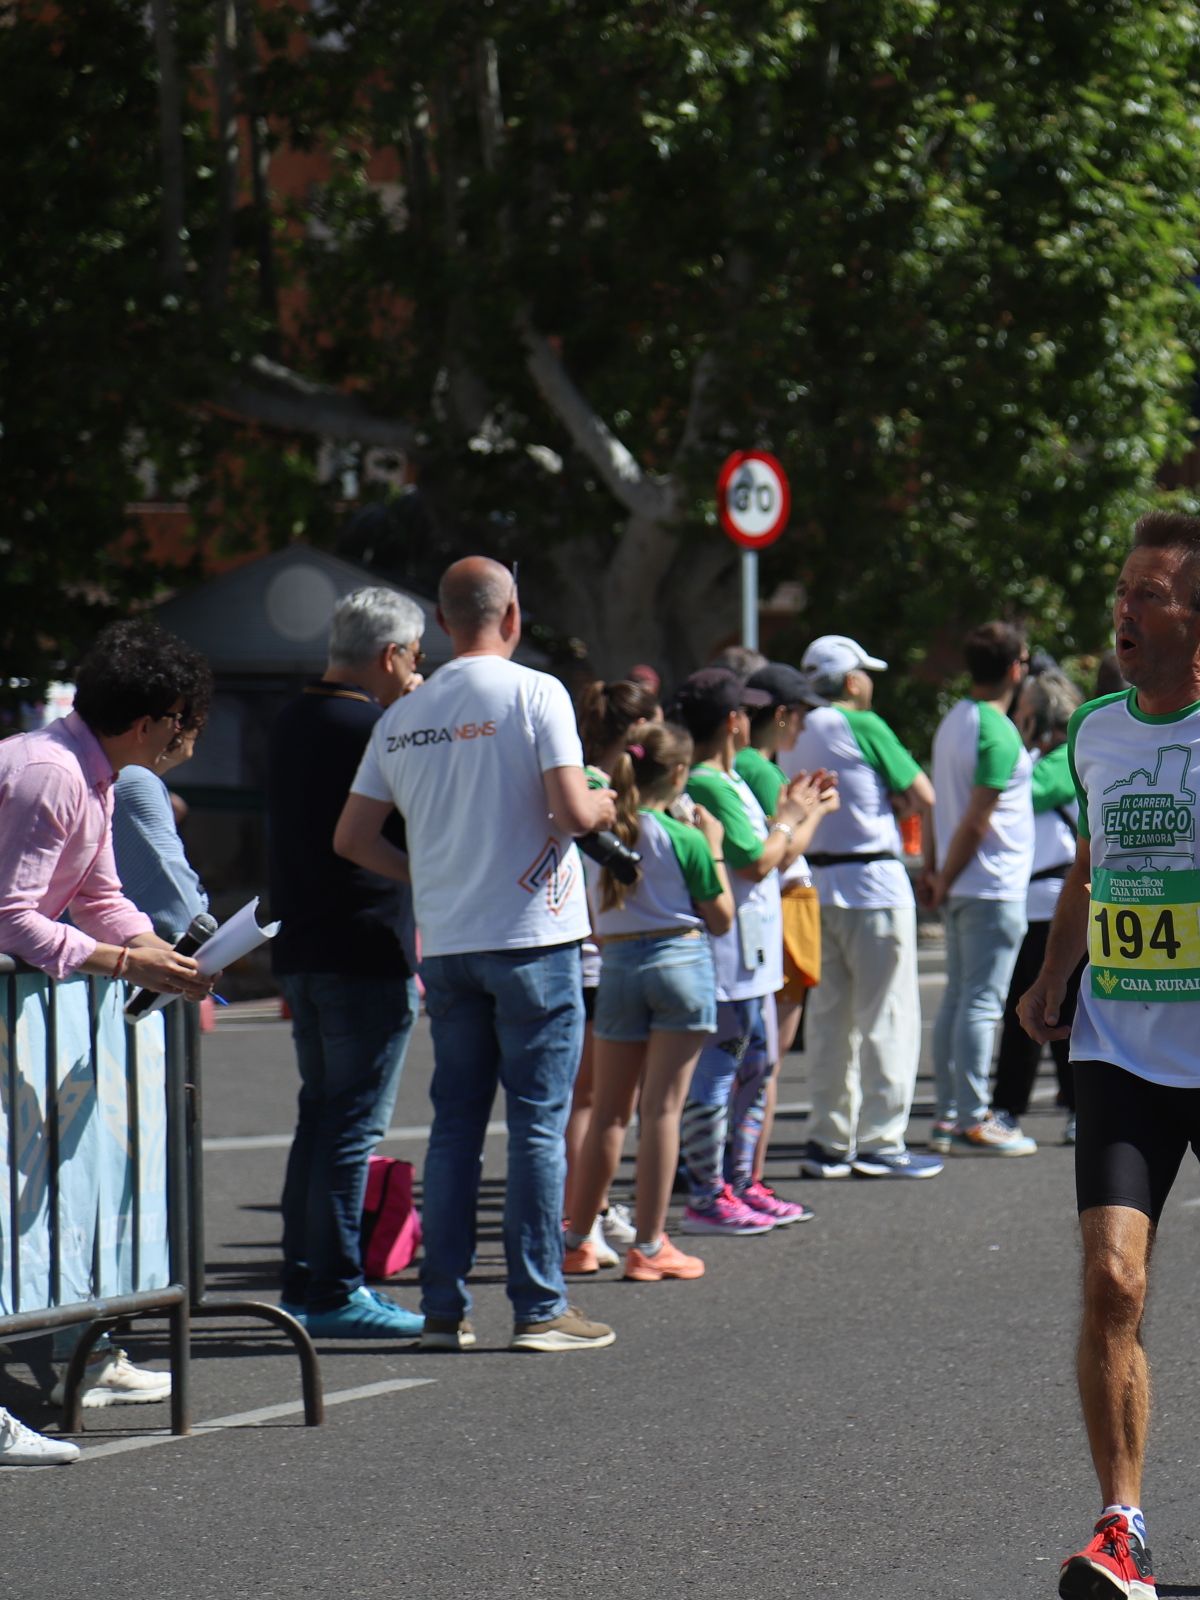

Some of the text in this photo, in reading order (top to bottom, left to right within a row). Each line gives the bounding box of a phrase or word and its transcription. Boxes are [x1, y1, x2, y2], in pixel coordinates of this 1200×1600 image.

[386, 720, 497, 753] ZAMORA NEWS
[1122, 797, 1171, 809] IX CARRERA
[1106, 809, 1188, 832] EL CERCO
[1123, 833, 1172, 845] DE ZAMORA
[1110, 887, 1165, 897] CAJA RURAL
[1095, 907, 1181, 960] 194
[1120, 977, 1152, 992] CAJA
